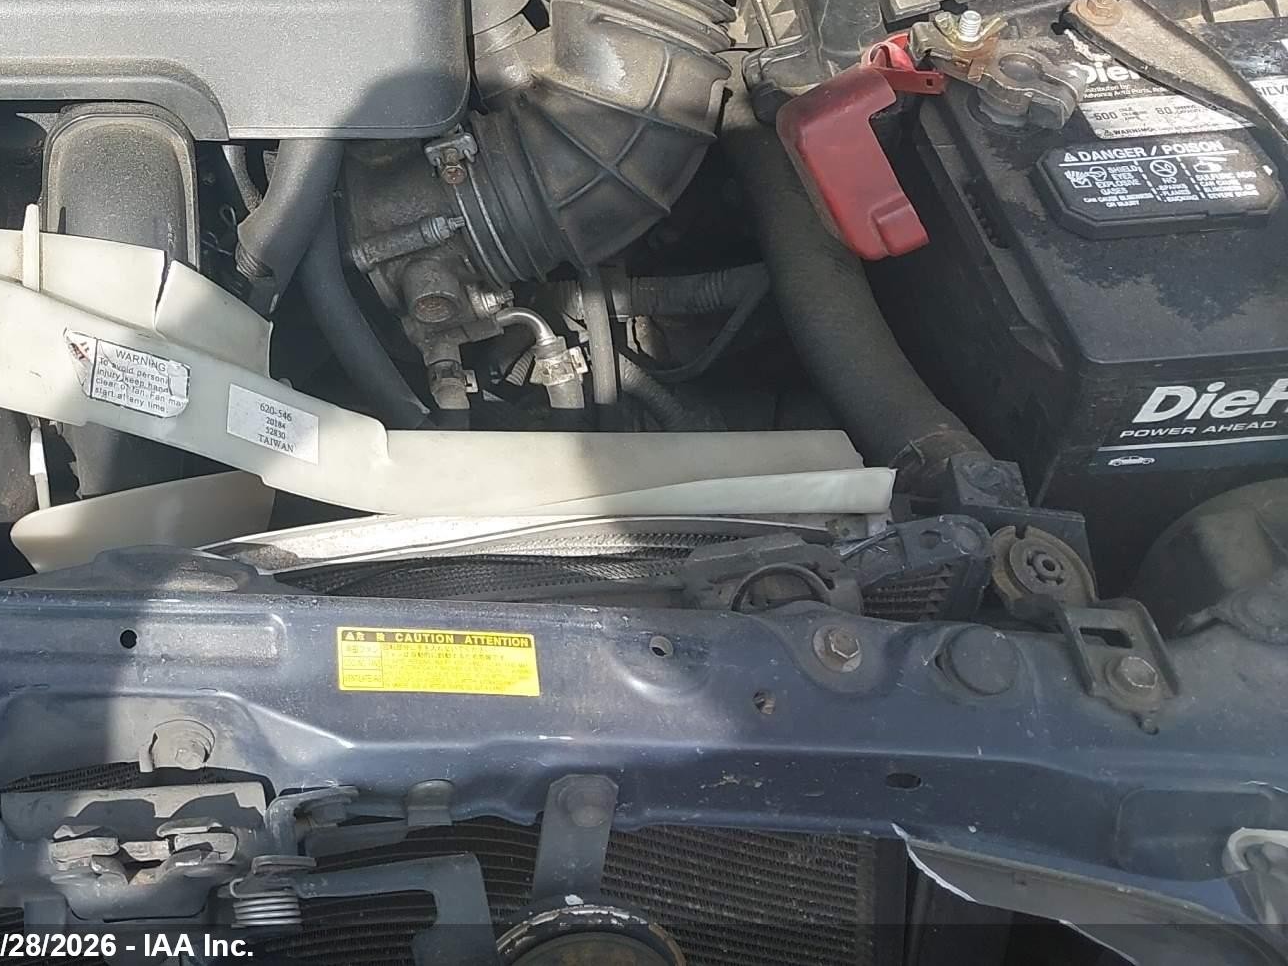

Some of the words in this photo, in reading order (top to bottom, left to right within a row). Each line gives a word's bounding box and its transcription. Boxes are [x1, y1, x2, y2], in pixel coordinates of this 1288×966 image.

[1078, 147, 1147, 162] DANGER
[1151, 146, 1157, 156] /
[1161, 141, 1225, 154] POISON
[99, 357, 108, 366] To
[116, 349, 166, 372] WARNING
[96, 377, 116, 387] clear
[95, 387, 114, 397] start
[129, 396, 144, 407] any
[260, 403, 292, 422] 620-546
[1119, 427, 1197, 439] POWER
[1201, 421, 1278, 434] AHEAD
[258, 433, 294, 453] TAIWAN
[395, 633, 454, 643] CAUTION
[465, 635, 529, 647] ATTENTION
